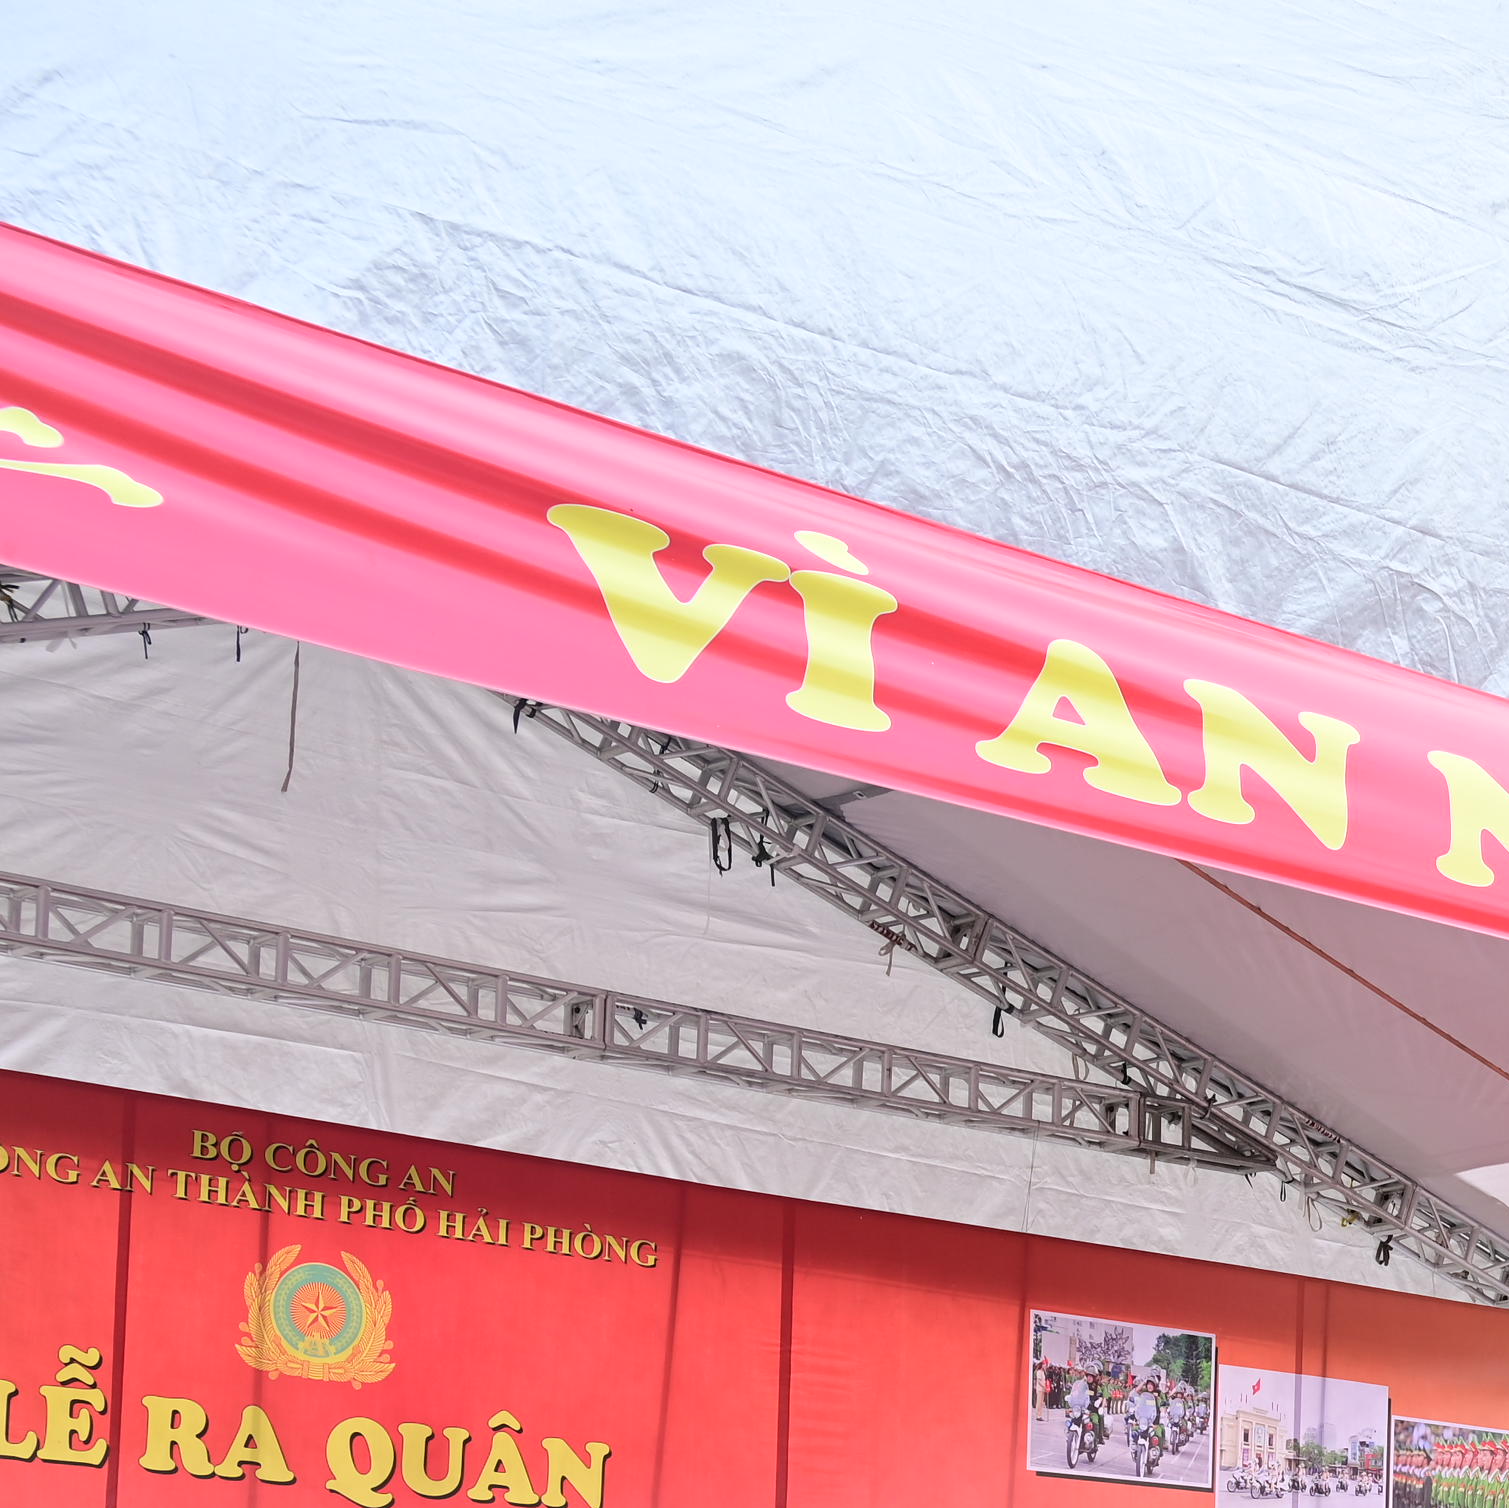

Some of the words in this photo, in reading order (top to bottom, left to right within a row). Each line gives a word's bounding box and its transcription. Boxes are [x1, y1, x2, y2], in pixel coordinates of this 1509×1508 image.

[547, 503, 898, 732] VÌ
[975, 639, 1359, 850] AN
[192, 1130, 251, 1171] BỘ
[265, 1139, 388, 1187] CÔNG
[399, 1164, 456, 1197] AN
[91, 1159, 155, 1194] AN
[168, 1168, 325, 1220] THÀNH
[338, 1194, 425, 1234] PHỐ
[437, 1207, 511, 1246] HẢI
[522, 1222, 657, 1267] PHÒNG
[139, 1396, 294, 1483] RA
